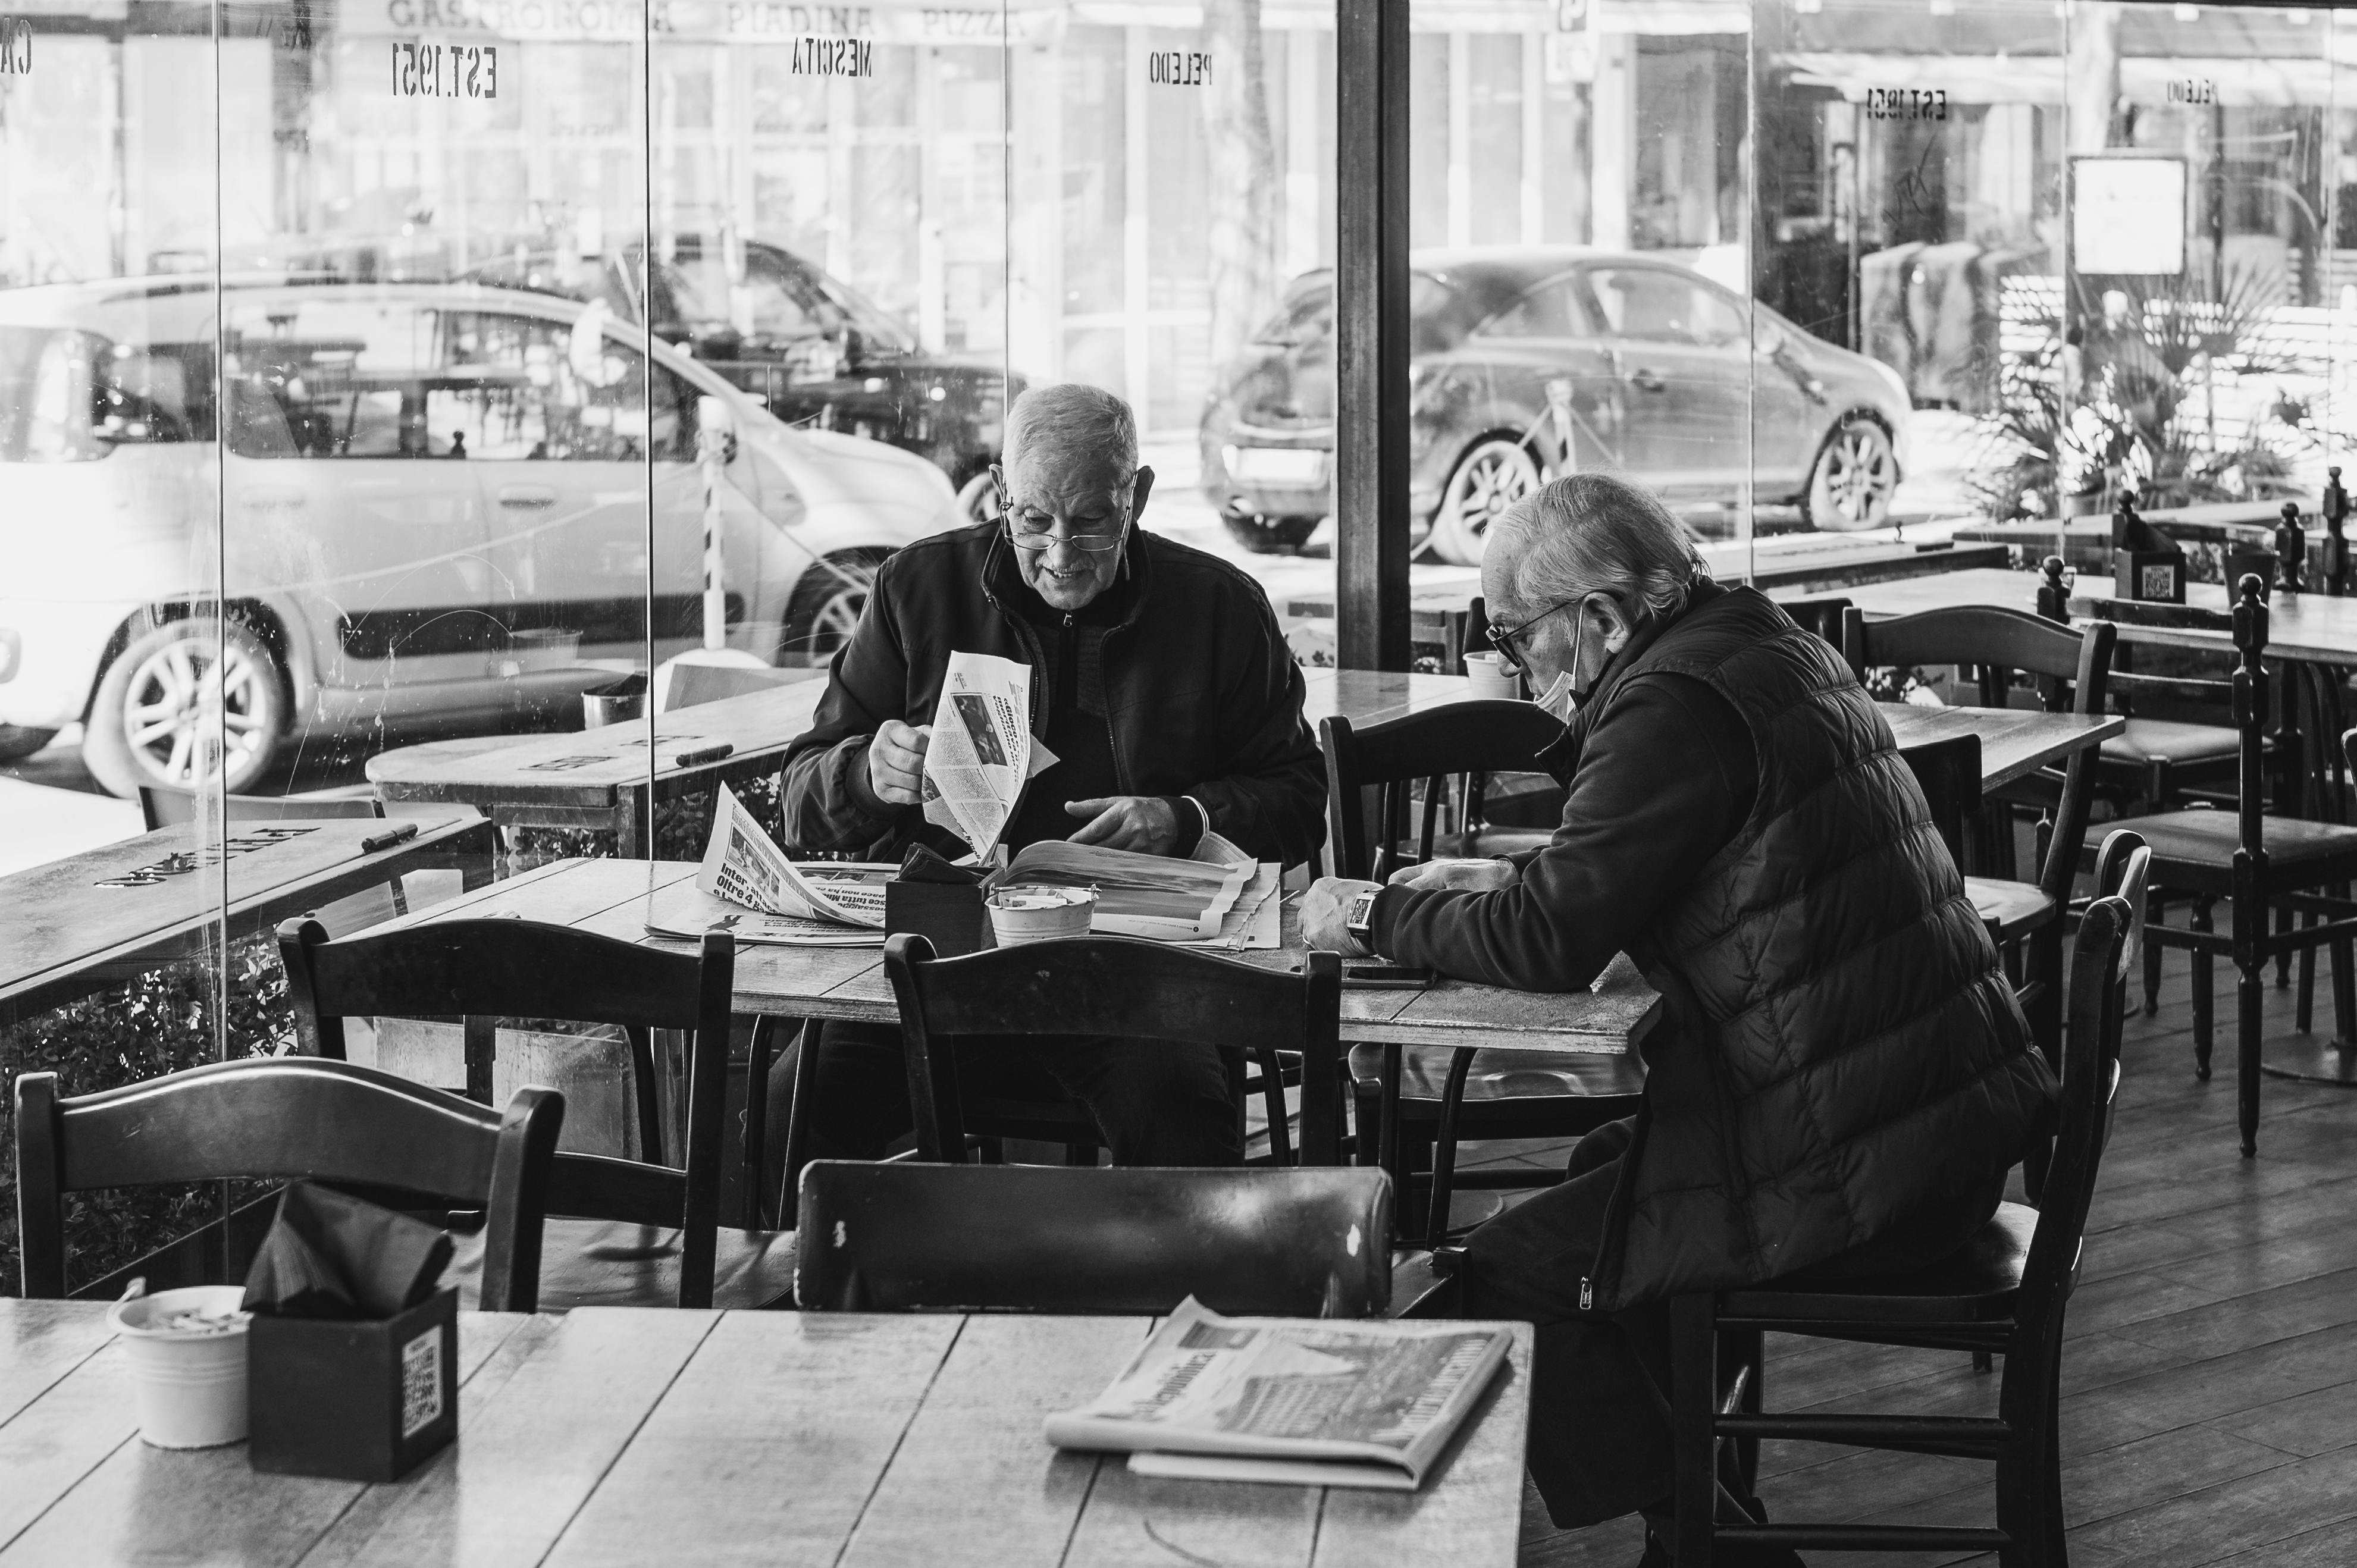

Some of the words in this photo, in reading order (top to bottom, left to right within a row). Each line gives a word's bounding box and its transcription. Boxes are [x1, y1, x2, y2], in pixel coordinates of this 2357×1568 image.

[717, 875, 744, 899] Oltre
[745, 893, 753, 904] 4
[842, 896, 867, 904] tutta
